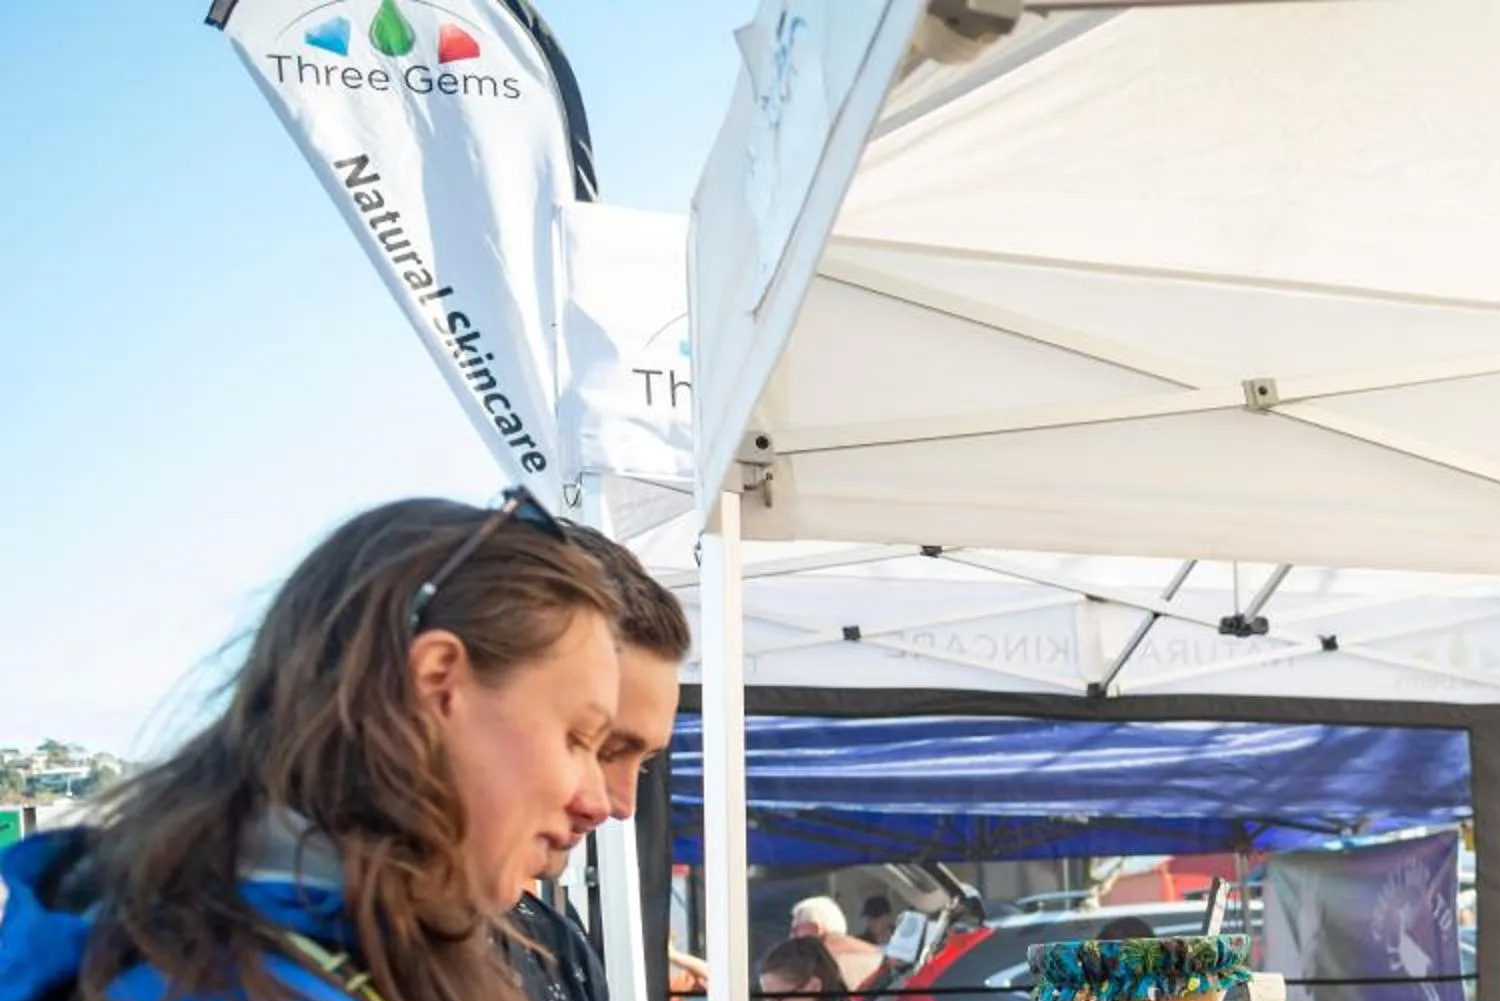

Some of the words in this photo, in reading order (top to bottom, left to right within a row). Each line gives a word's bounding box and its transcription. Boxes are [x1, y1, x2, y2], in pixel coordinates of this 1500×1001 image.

[266, 53, 390, 92] Three
[404, 64, 522, 99] Gems
[333, 154, 454, 307] Natural
[433, 310, 548, 475] Skincare
